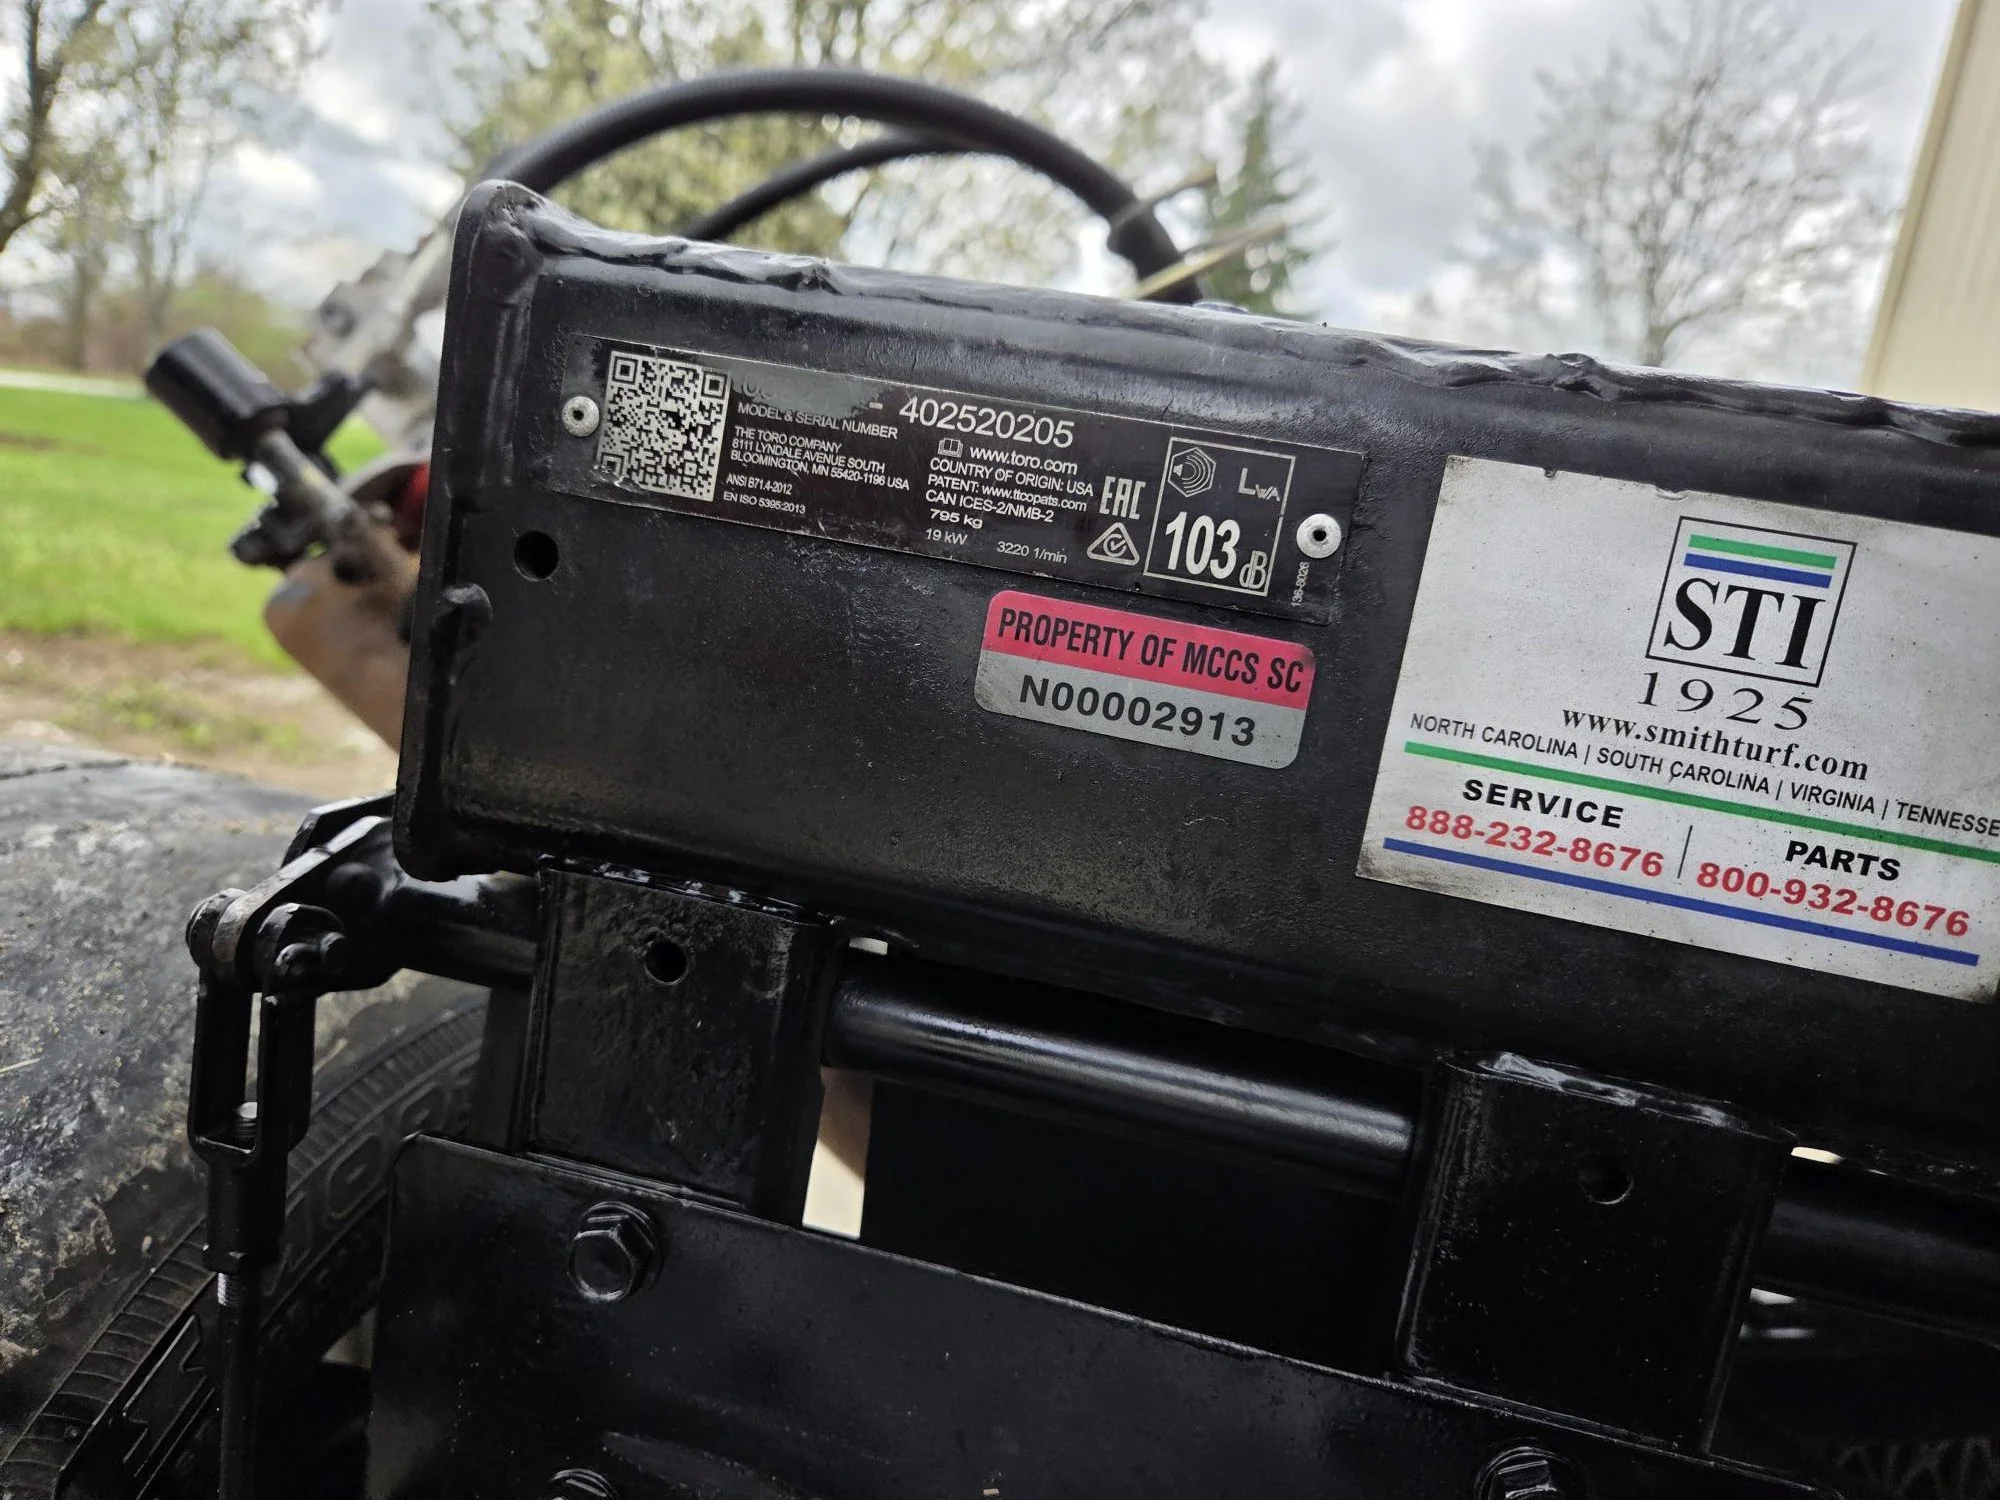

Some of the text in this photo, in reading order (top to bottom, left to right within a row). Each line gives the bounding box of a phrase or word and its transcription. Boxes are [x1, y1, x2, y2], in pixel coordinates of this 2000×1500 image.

[734, 426, 842, 453] THE TORO COMPANY
[738, 402, 898, 440] MODEL & SERIAL NUMBER
[899, 396, 1075, 448] 402520205
[731, 451, 910, 491] BLOOMINGTON, MN 55420-1196 USA
[732, 438, 885, 473] 8111 LYNDALE AVENUE SOUTH
[970, 446, 1078, 475] www.toro.com
[726, 474, 793, 495] ANSI B71.4-2012
[928, 474, 1087, 512] PATENT: www.ttcopats.com
[930, 457, 1094, 496] COUNTRY OF ORIGIN: USA
[723, 491, 806, 514] EN ISO 5395:2013
[925, 489, 1055, 523] CAN ICES-2/NMB-2
[929, 508, 983, 529] 795 kg
[925, 528, 968, 546] 19 kW
[996, 541, 1068, 563] 3220 1/min
[1165, 511, 1268, 589] 103 dB
[1291, 561, 1310, 608] 136-8026
[1663, 577, 1826, 670] STI
[998, 608, 1304, 693] PROPERTY OF MCCS SC
[1019, 674, 1256, 747] N00002913
[1637, 671, 1814, 731] 1925
[1410, 712, 1476, 739] NORTH
[1482, 726, 1578, 759] CAROLINA
[1597, 747, 1663, 774] SOUTH
[1670, 761, 1770, 794] CAROLINA
[1791, 782, 1875, 814] VIRGINIA
[1562, 709, 1869, 781] www.smithturf.com
[1462, 779, 1624, 829] SERVICE
[1405, 805, 1664, 877] 888-232-8676
[1785, 839, 1901, 881] PARTS
[1696, 862, 1970, 937] 800-932-8676
